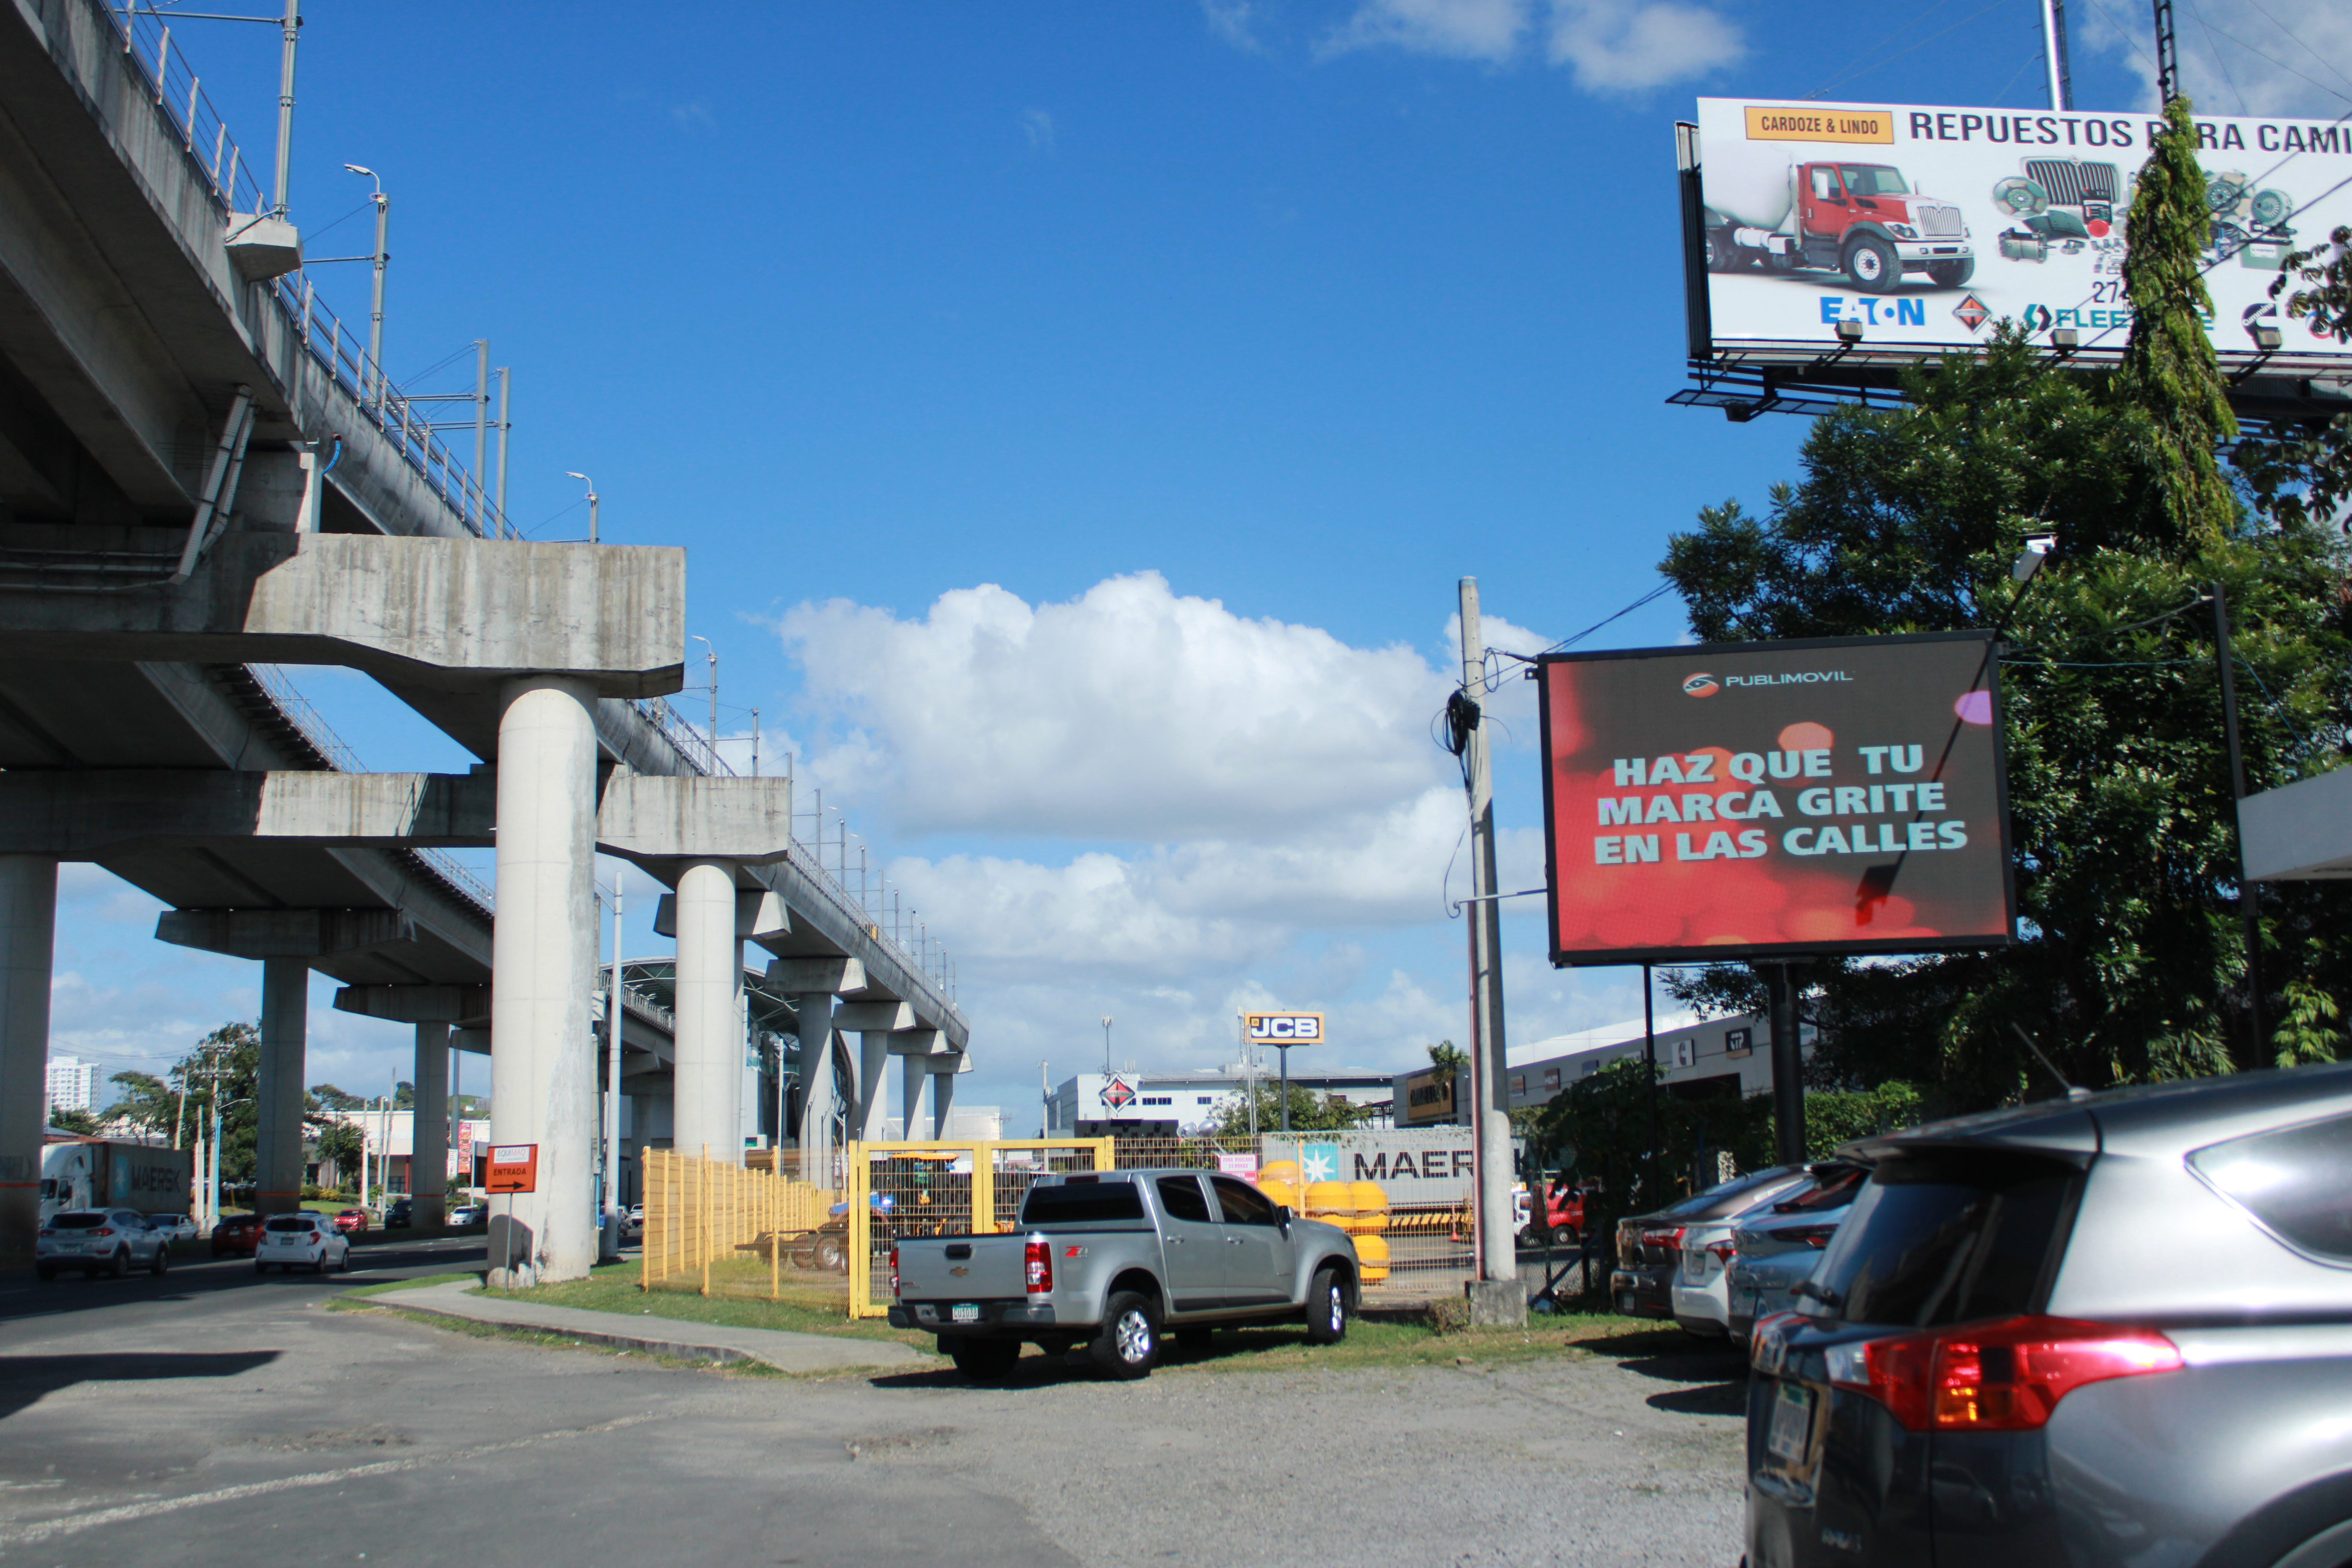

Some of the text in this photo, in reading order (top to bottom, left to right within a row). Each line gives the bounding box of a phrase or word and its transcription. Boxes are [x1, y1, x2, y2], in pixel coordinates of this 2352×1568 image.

[1762, 116, 1878, 134] CARDOZE & LINDO
[1909, 112, 2351, 154] REPUESTOS PRA CAMI
[1726, 671, 1853, 687] PUBLIMOVIL
[1614, 744, 1924, 786] HAZ QUE TU
[1598, 782, 1947, 826] MARCA GRITE
[1595, 820, 1968, 864] EN LAS CALLES
[1251, 1018, 1318, 1037] JCB
[1354, 1148, 1521, 1180] MAER
[132, 1165, 181, 1193] MAERSK
[1065, 1246, 1089, 1257] Z71
[954, 1308, 977, 1318] CU1038
